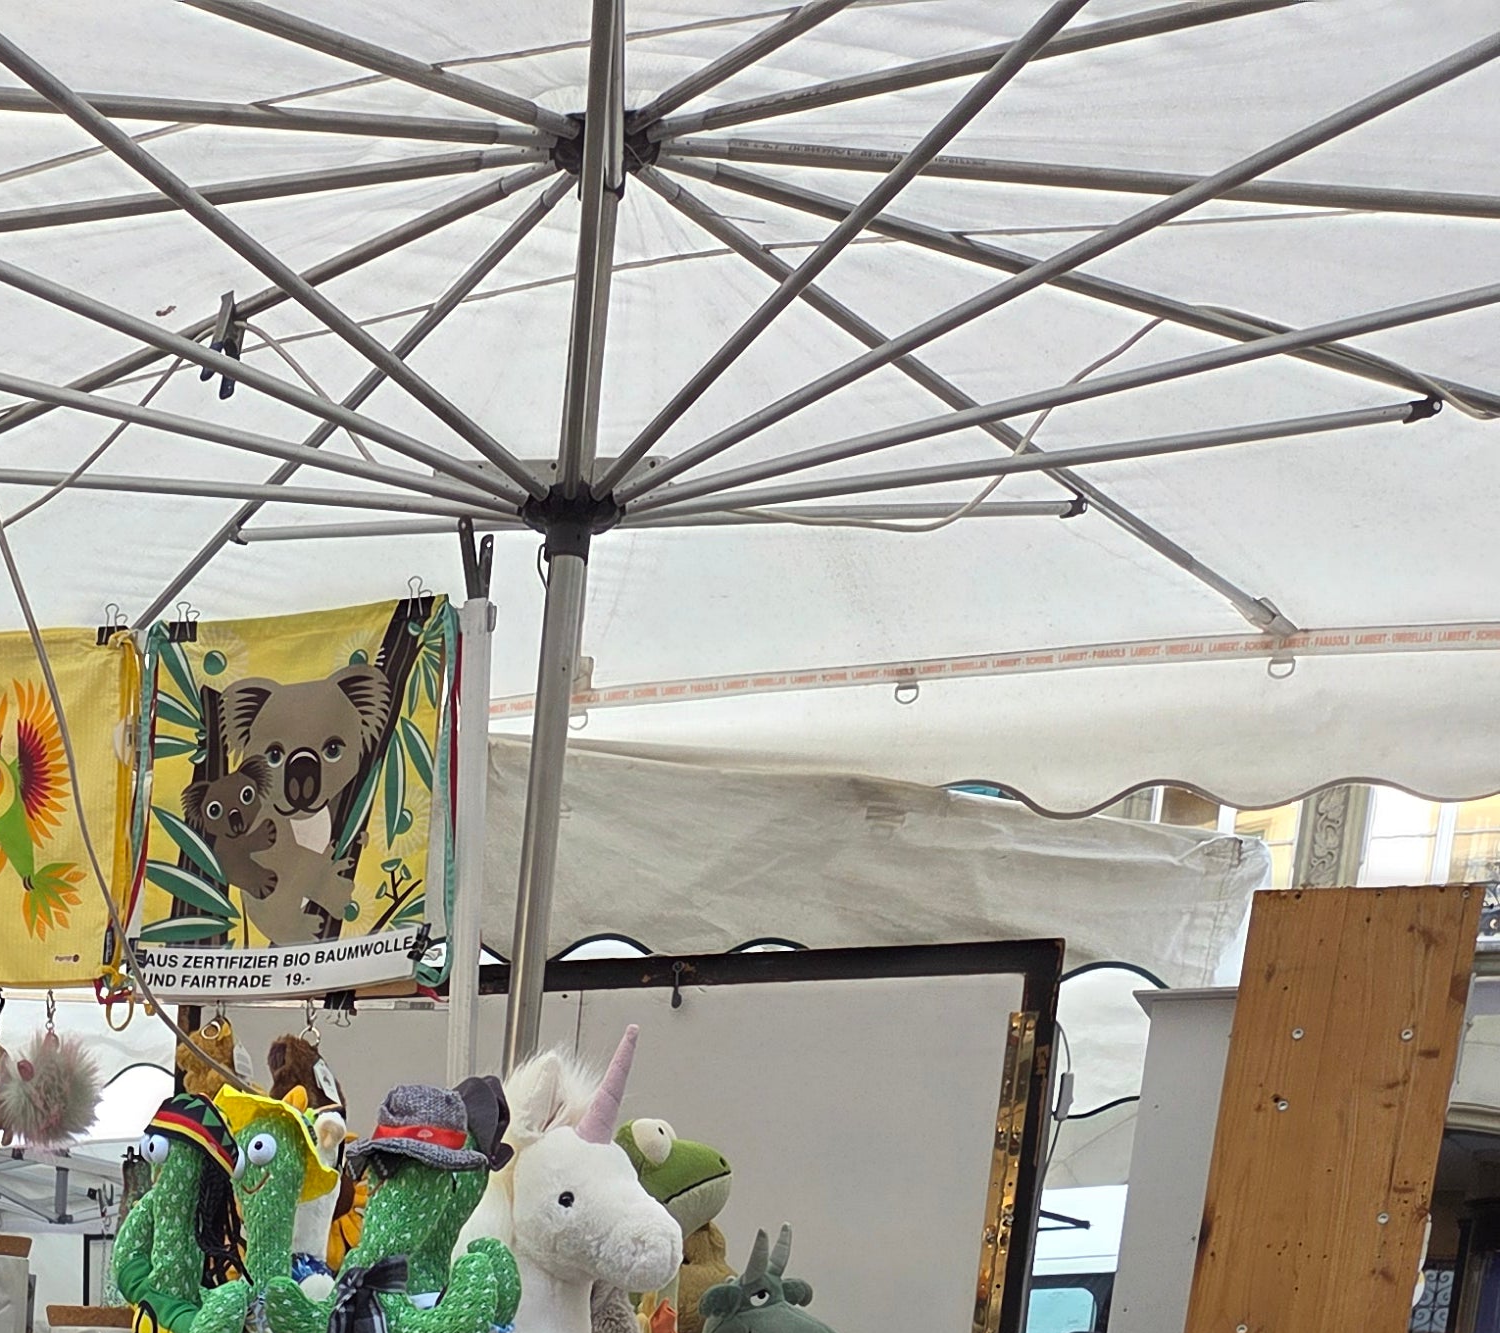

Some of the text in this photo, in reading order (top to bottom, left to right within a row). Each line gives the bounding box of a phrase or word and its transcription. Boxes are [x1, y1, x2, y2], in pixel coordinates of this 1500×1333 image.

[146, 935, 415, 970] AUS ZERTIFIZIER BIO BAUMWOLLE
[142, 972, 312, 989] UND FAIRTRADE 19.-
